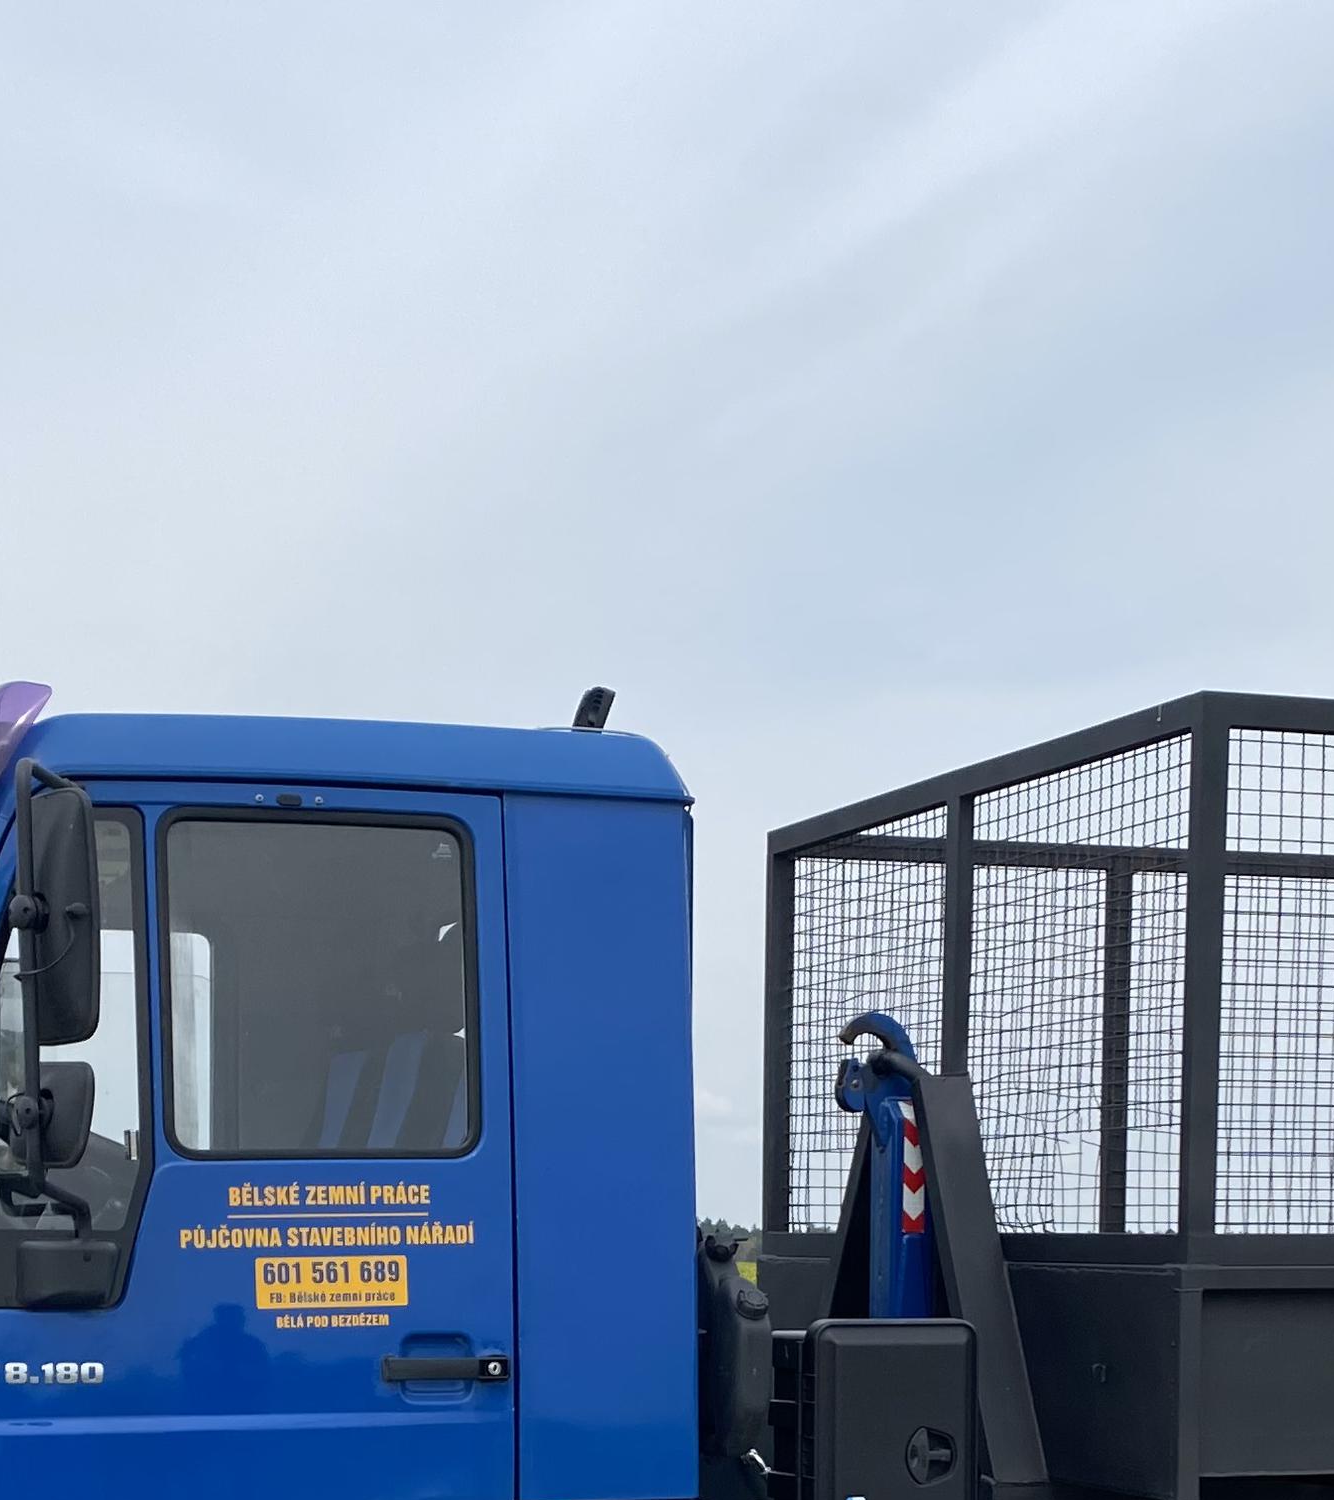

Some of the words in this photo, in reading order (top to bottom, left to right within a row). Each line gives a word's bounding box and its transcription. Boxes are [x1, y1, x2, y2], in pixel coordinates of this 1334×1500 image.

[228, 1182, 300, 1207] BĚLSKÉ
[305, 1182, 366, 1205] ZEMNÍ
[370, 1181, 431, 1205] PRÁCE
[287, 1221, 401, 1248] STAVEBNÍHO
[405, 1220, 475, 1245] NÁŘADÍ
[263, 1261, 302, 1285] 601
[311, 1260, 351, 1284] 561
[359, 1259, 400, 1283] 689
[269, 1292, 287, 1304] FB:
[306, 1314, 329, 1328] POD
[4, 1361, 105, 1384] 8.180
